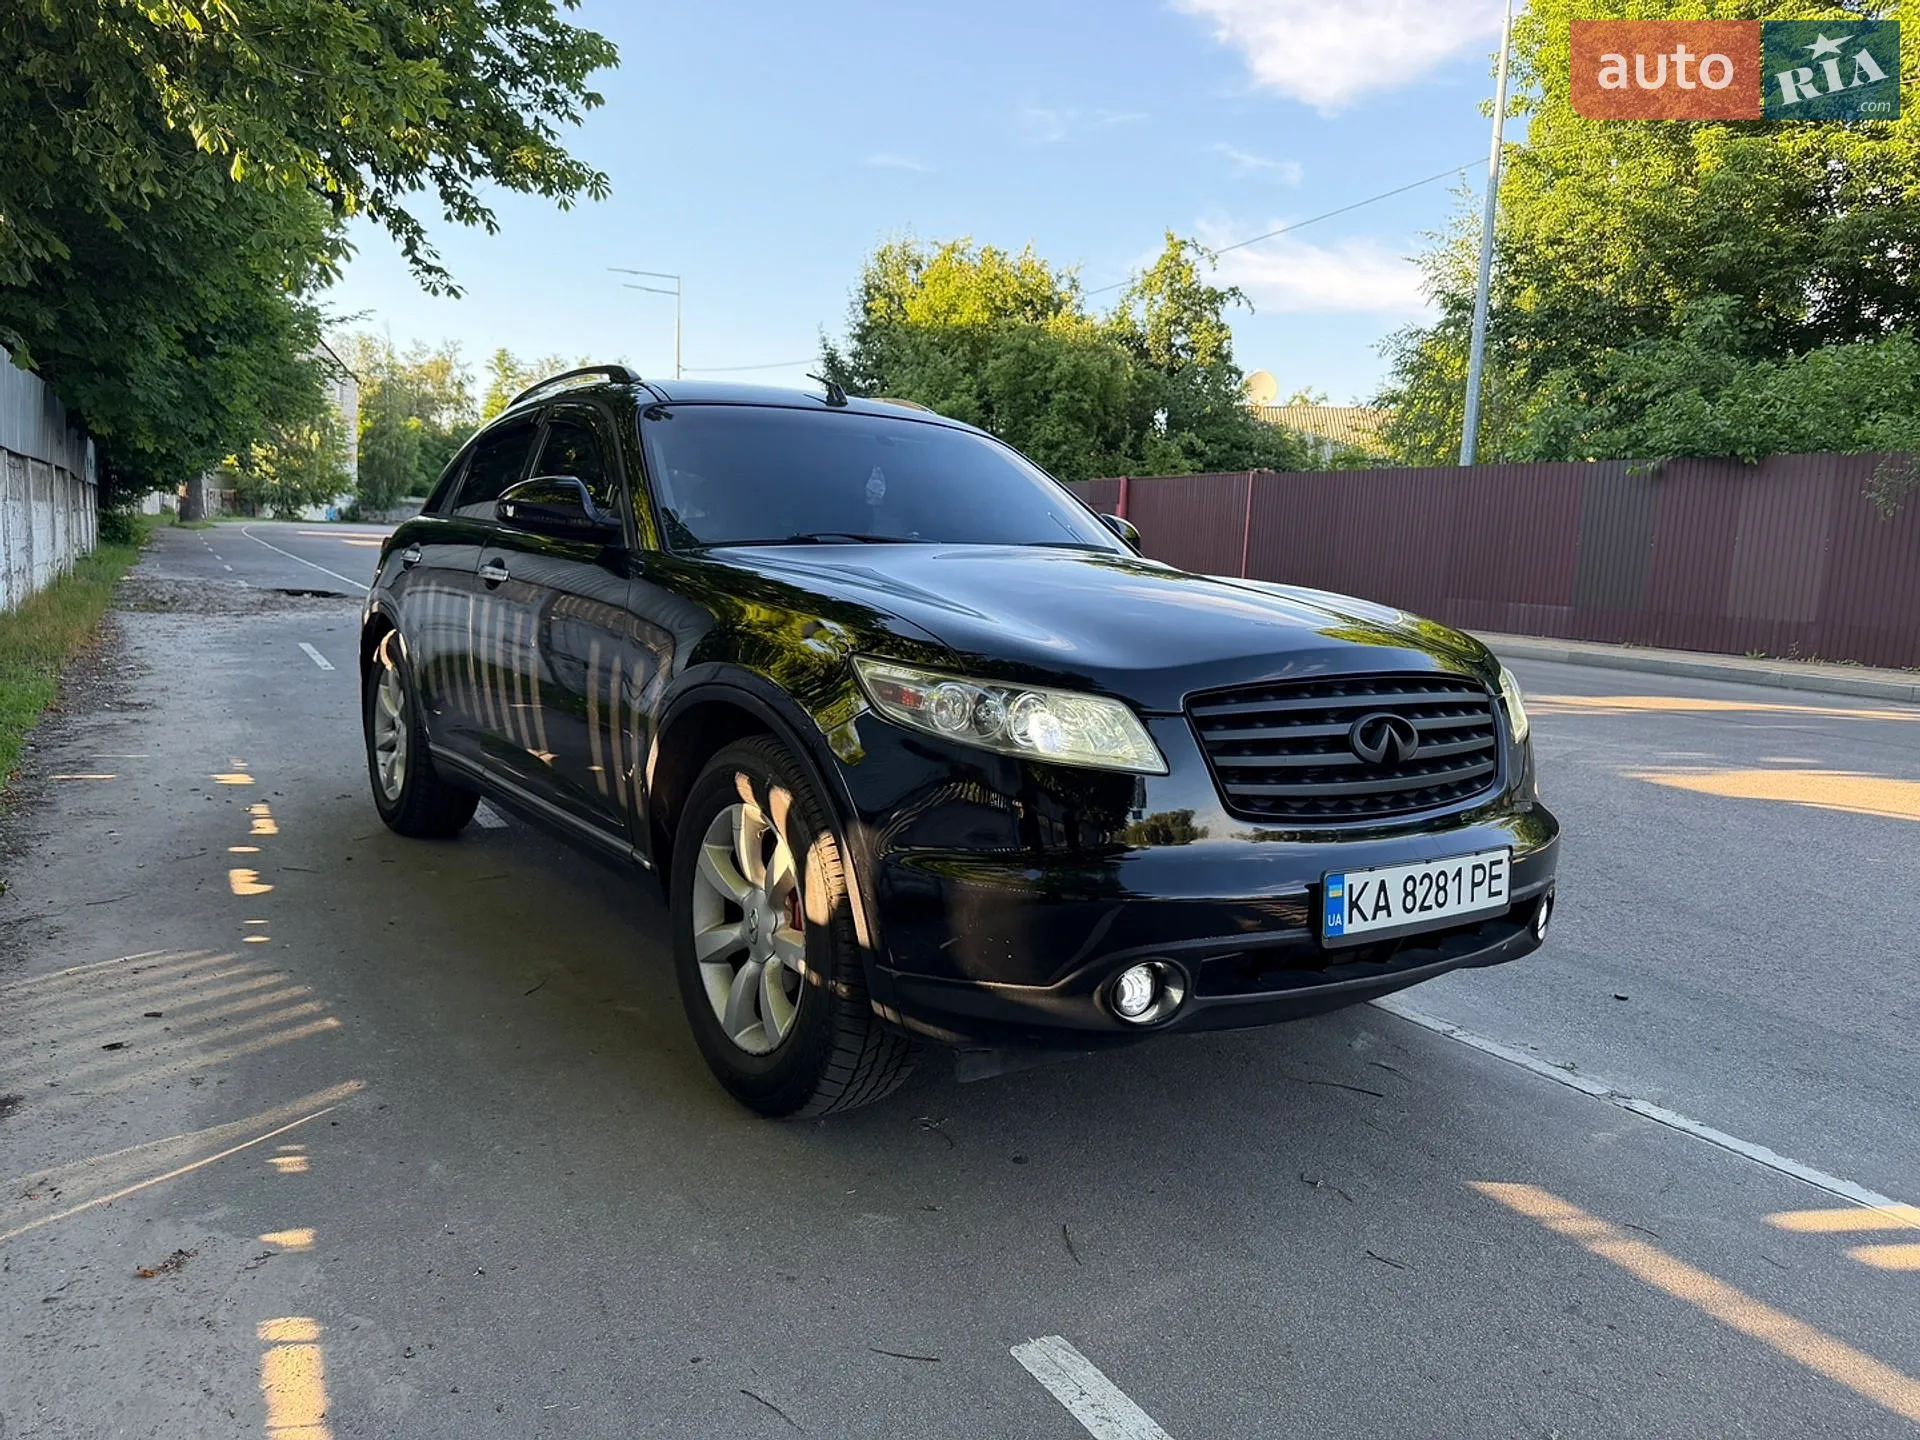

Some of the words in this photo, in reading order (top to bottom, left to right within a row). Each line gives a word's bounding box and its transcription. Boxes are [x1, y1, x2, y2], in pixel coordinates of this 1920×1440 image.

[1347, 878, 1392, 925] KA
[1402, 866, 1463, 914] 8281
[1470, 858, 1504, 902] PE
[1328, 913, 1342, 927] UA
